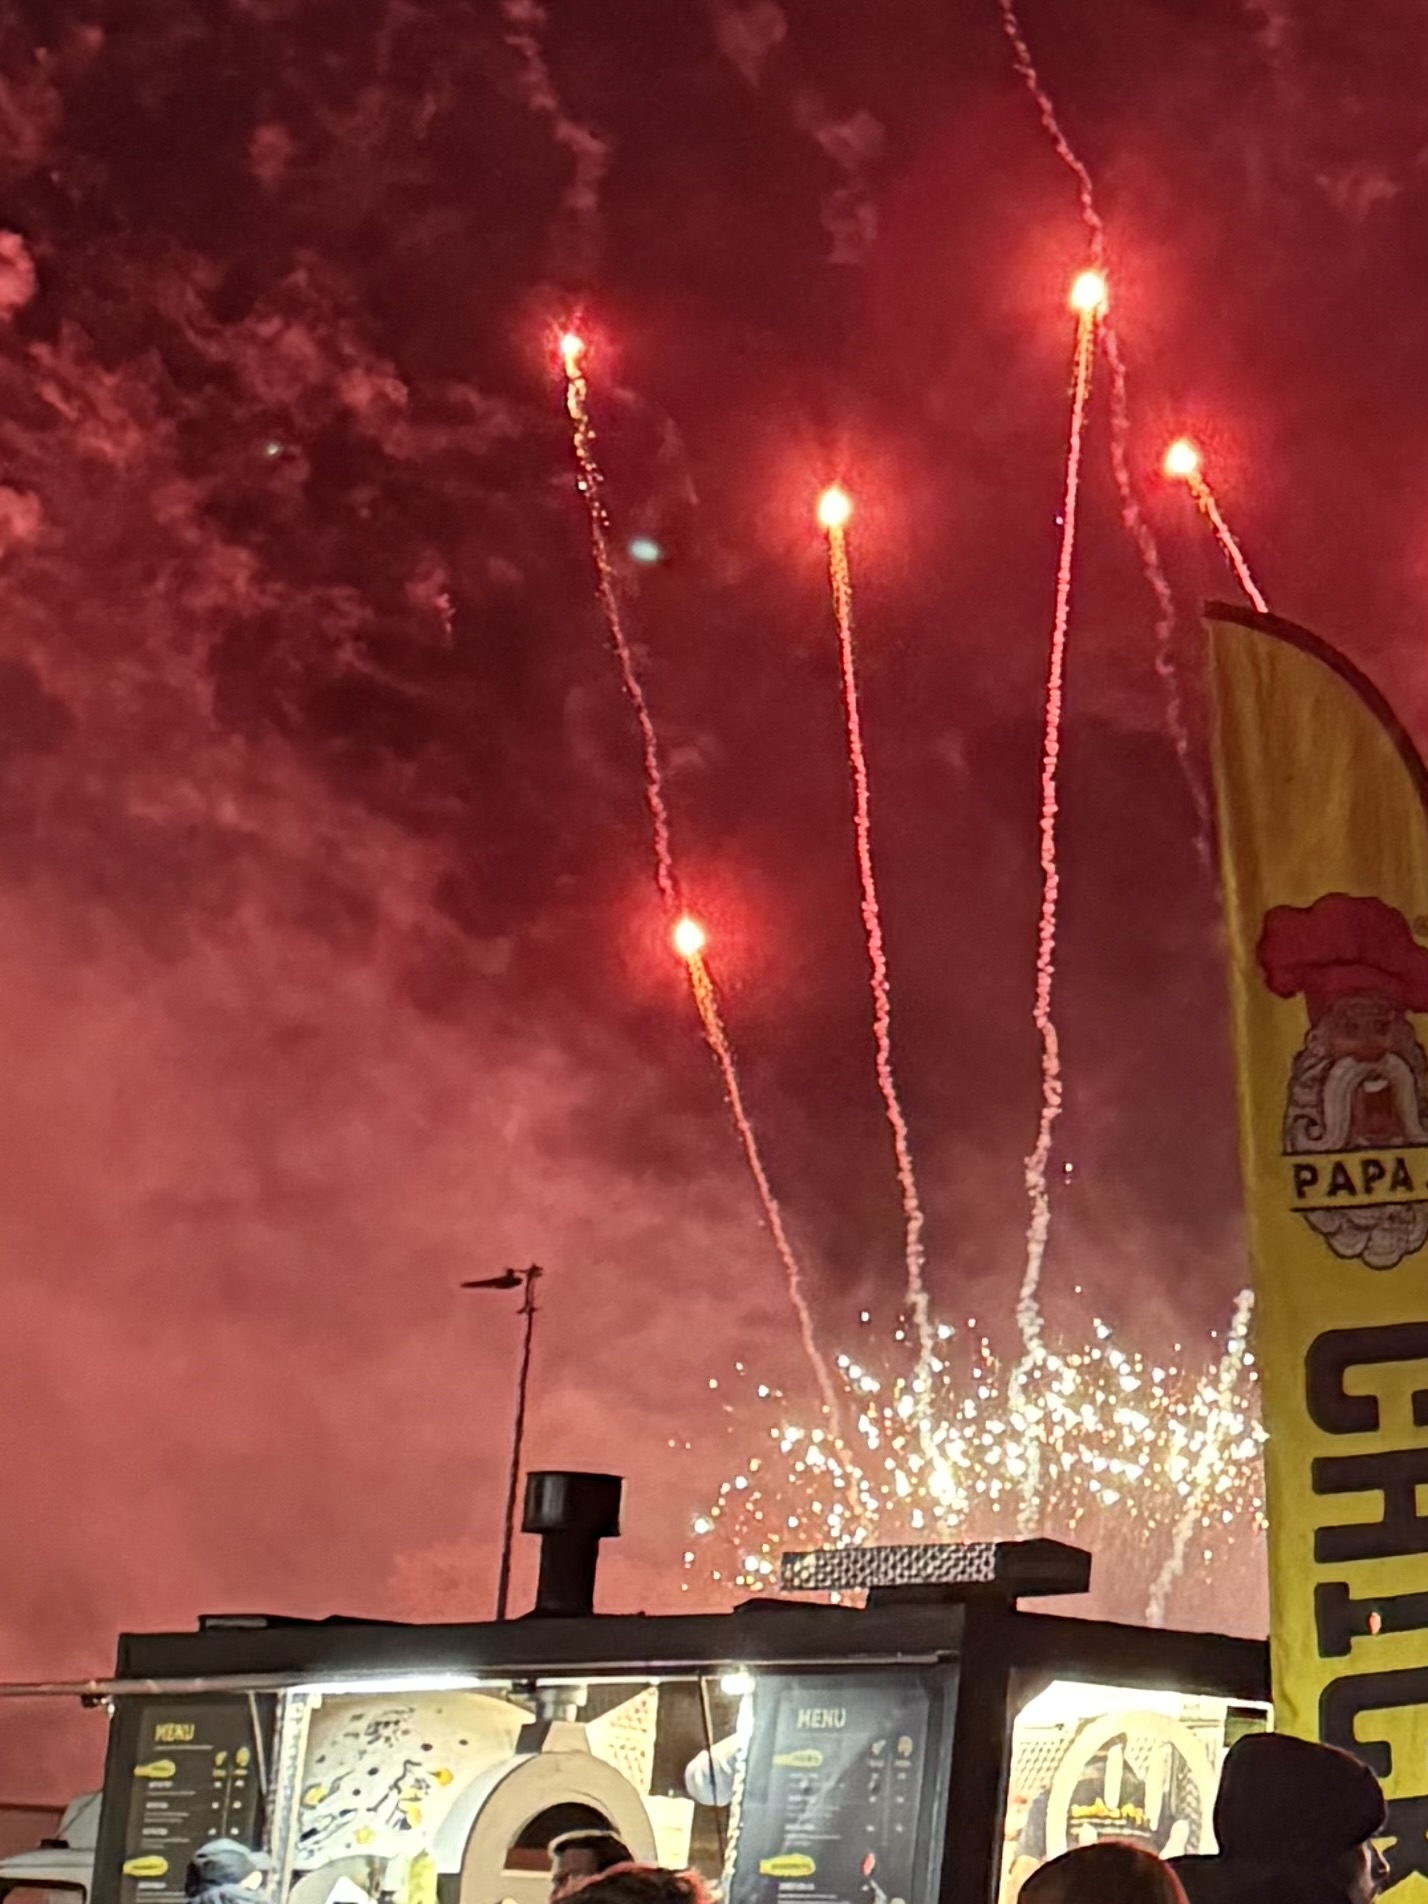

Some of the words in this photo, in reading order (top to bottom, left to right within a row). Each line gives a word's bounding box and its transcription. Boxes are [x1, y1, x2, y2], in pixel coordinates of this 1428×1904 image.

[1292, 1156, 1415, 1200] PAPA
[796, 1708, 847, 1729] MENU
[154, 1724, 196, 1742] MENU
